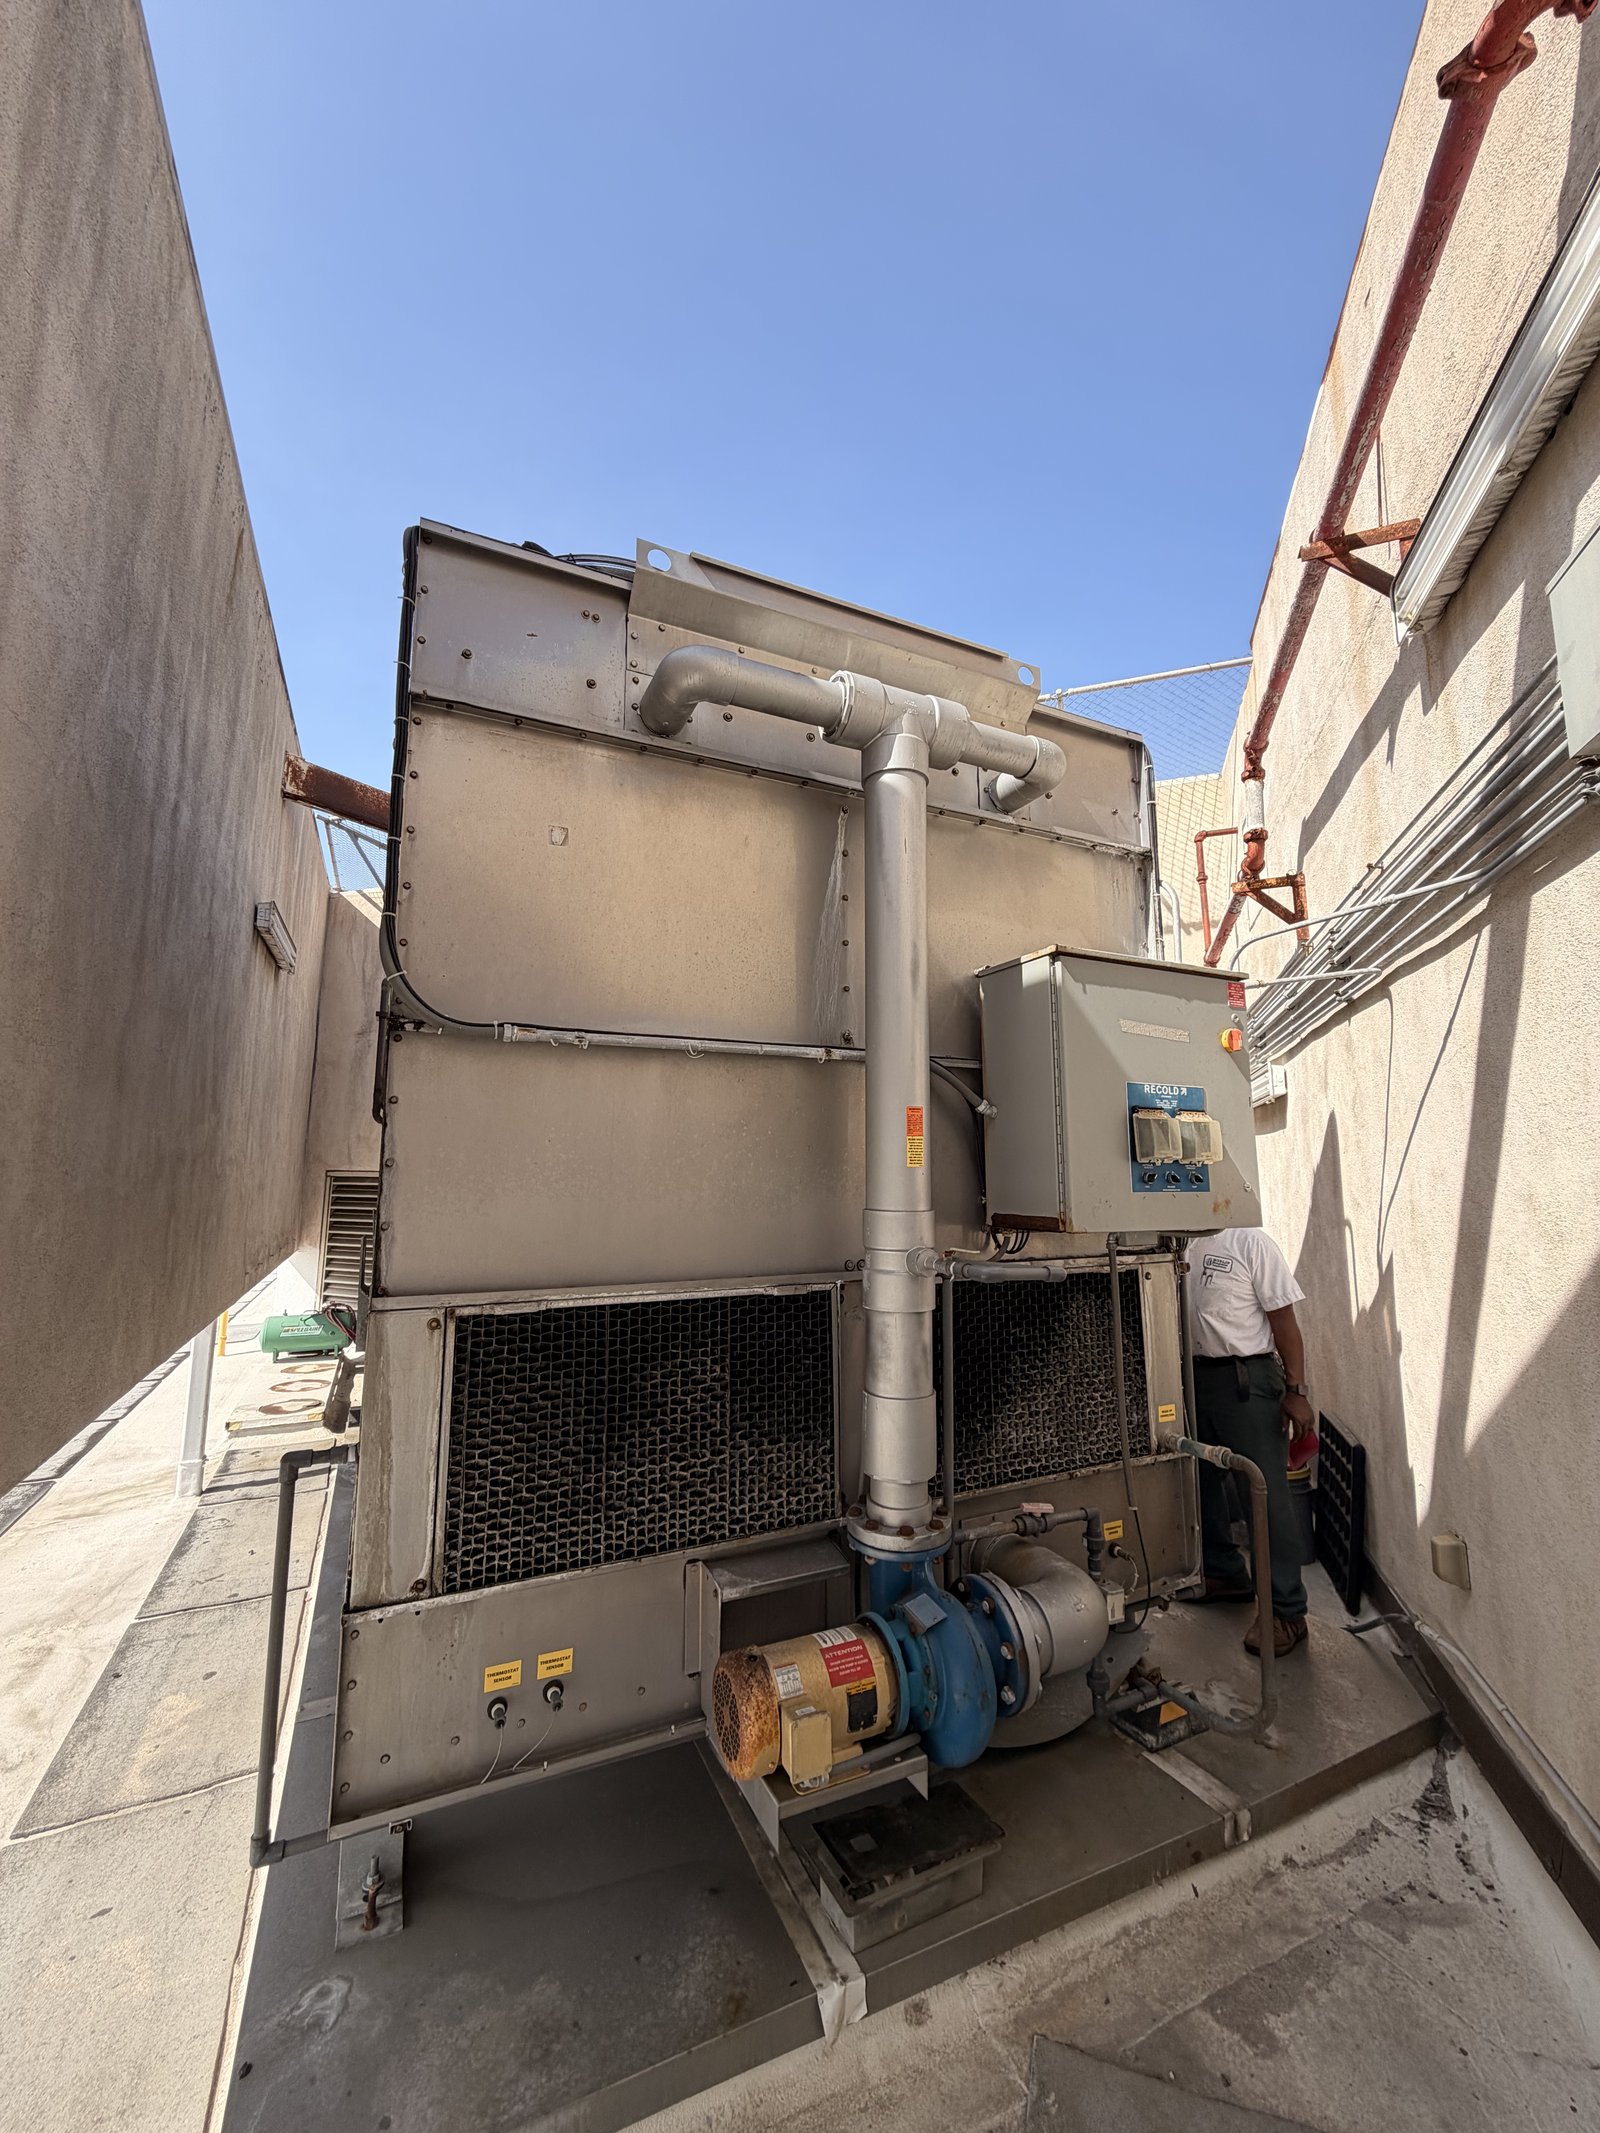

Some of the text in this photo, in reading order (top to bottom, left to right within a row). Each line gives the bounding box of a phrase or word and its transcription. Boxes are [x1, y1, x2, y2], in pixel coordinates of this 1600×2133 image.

[1144, 1085, 1179, 1096] RECOLD
[825, 1645, 863, 1659] ATTENTION
[540, 1655, 571, 1665] THERMOSTAT
[546, 1663, 564, 1671] SENSOR
[487, 1667, 519, 1678] THERMOSTAT
[494, 1675, 512, 1683] SENSOR
